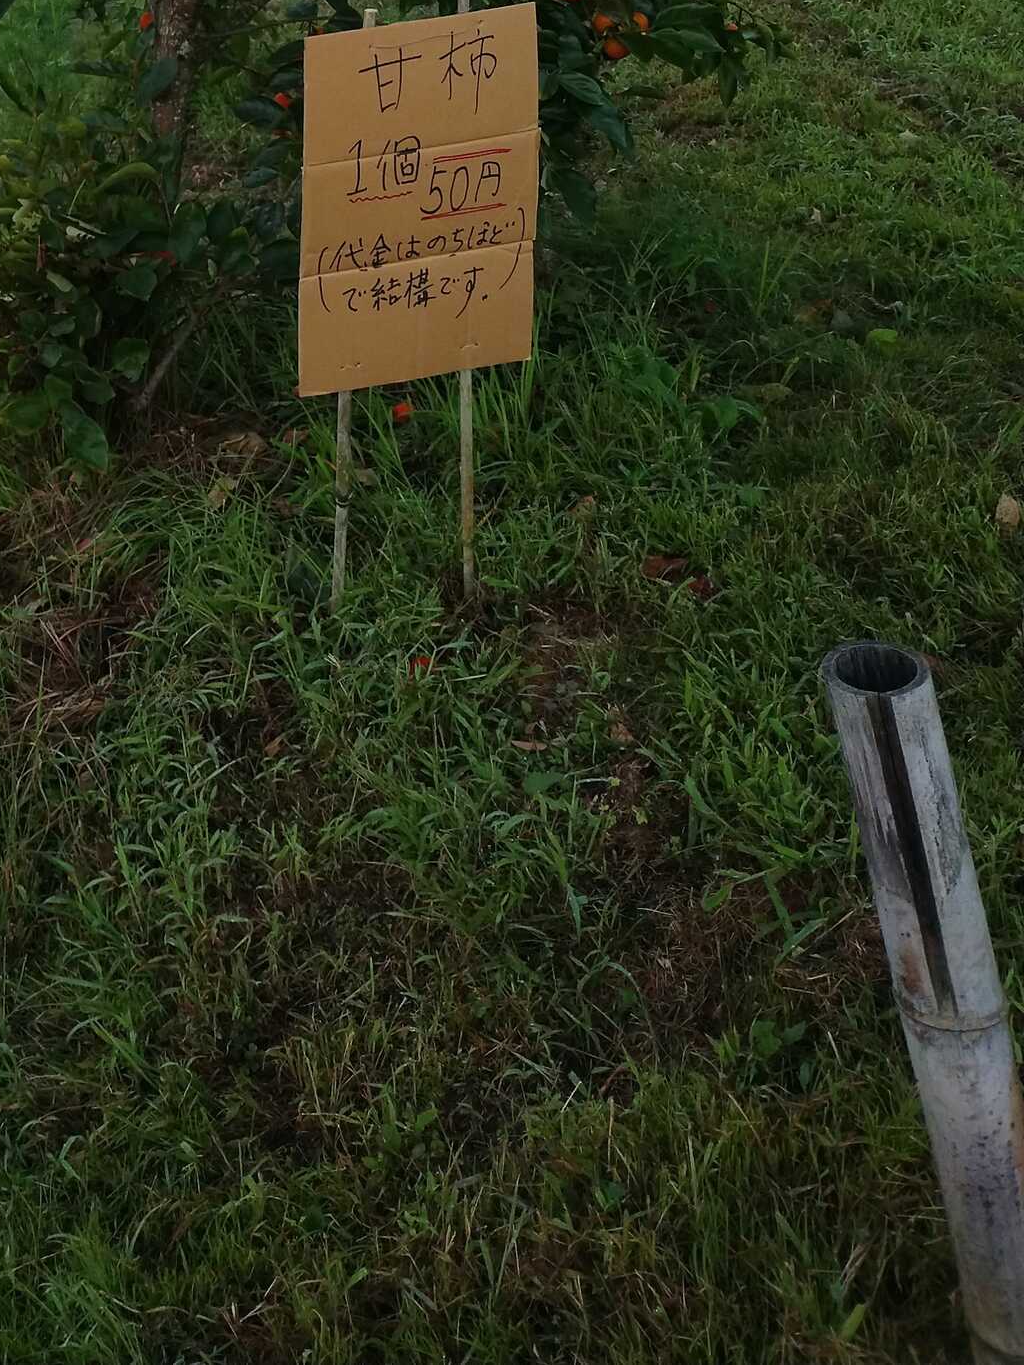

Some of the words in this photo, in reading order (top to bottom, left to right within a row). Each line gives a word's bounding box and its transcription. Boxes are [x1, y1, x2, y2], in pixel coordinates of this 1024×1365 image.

[358, 28, 498, 115] 甘柿
[346, 135, 422, 196] 1個
[419, 160, 502, 215] 50円
